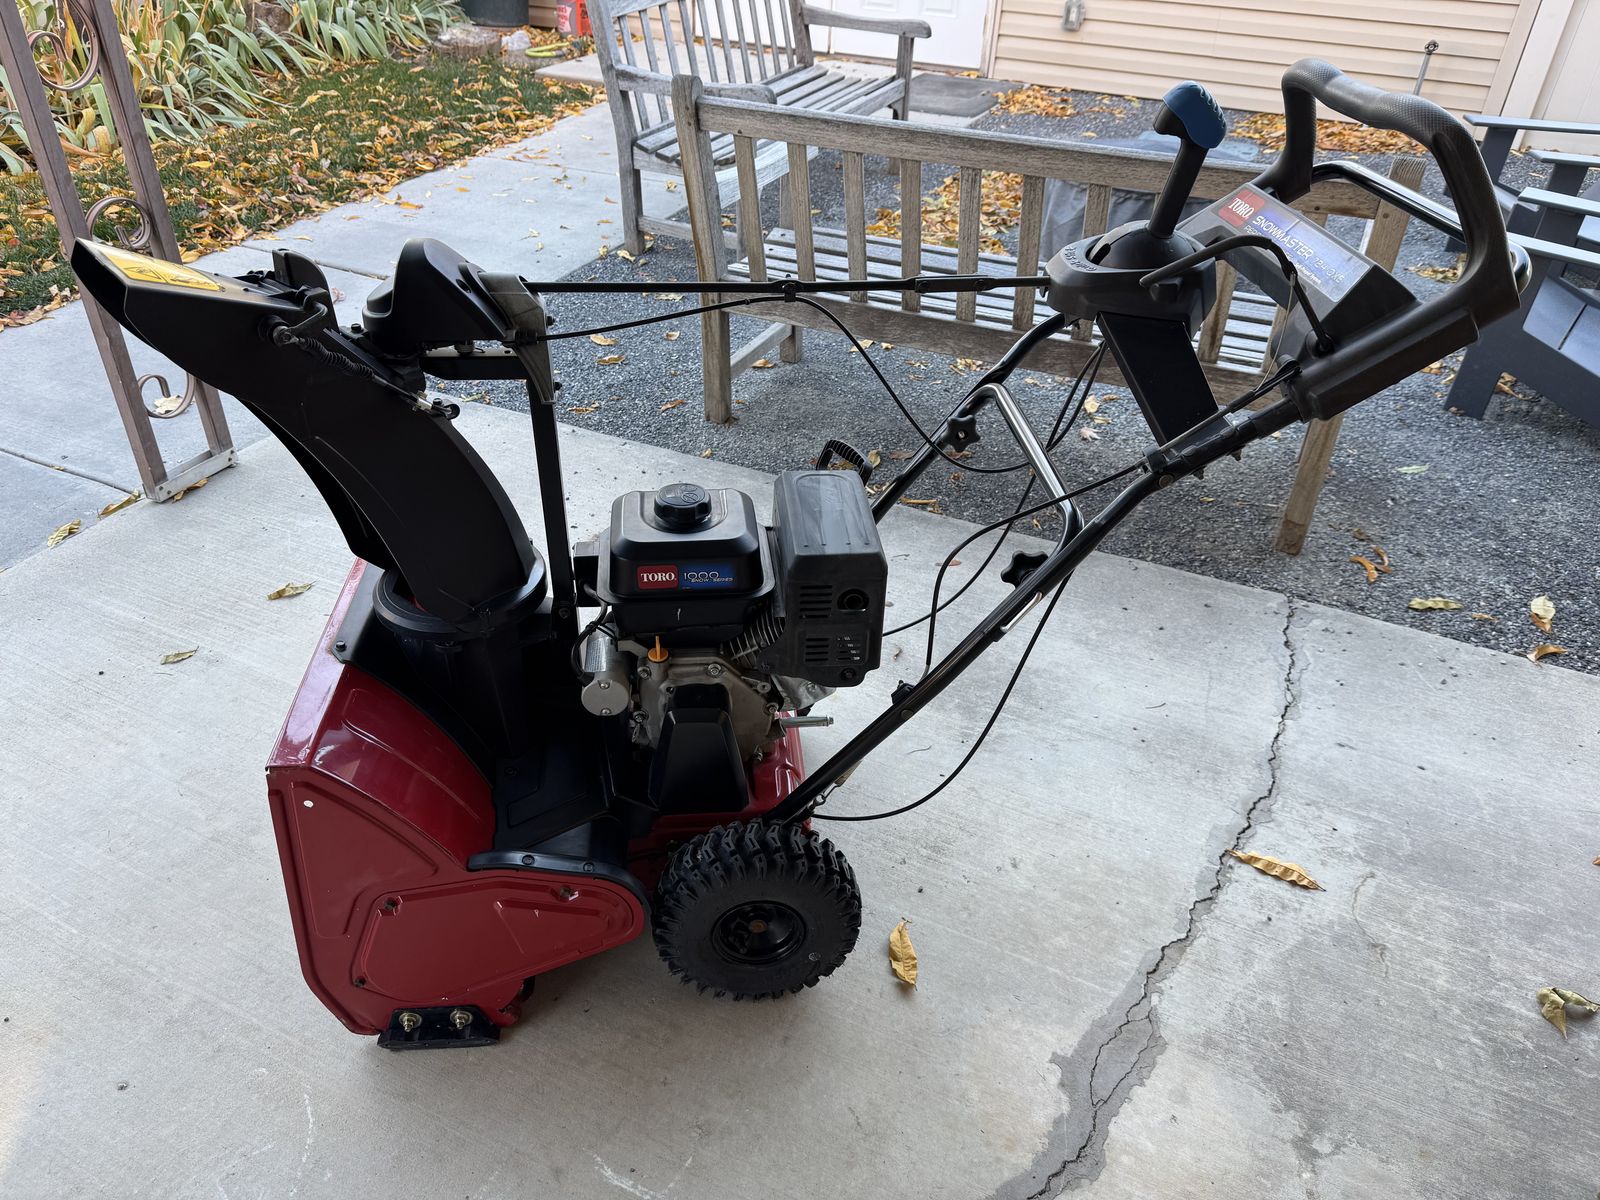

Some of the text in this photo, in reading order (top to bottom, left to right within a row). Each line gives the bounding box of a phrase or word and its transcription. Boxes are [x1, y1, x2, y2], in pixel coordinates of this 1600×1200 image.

[1228, 197, 1255, 218] TORO
[1252, 215, 1314, 260] SNOWMASTER
[640, 571, 719, 582] TORO 1000
